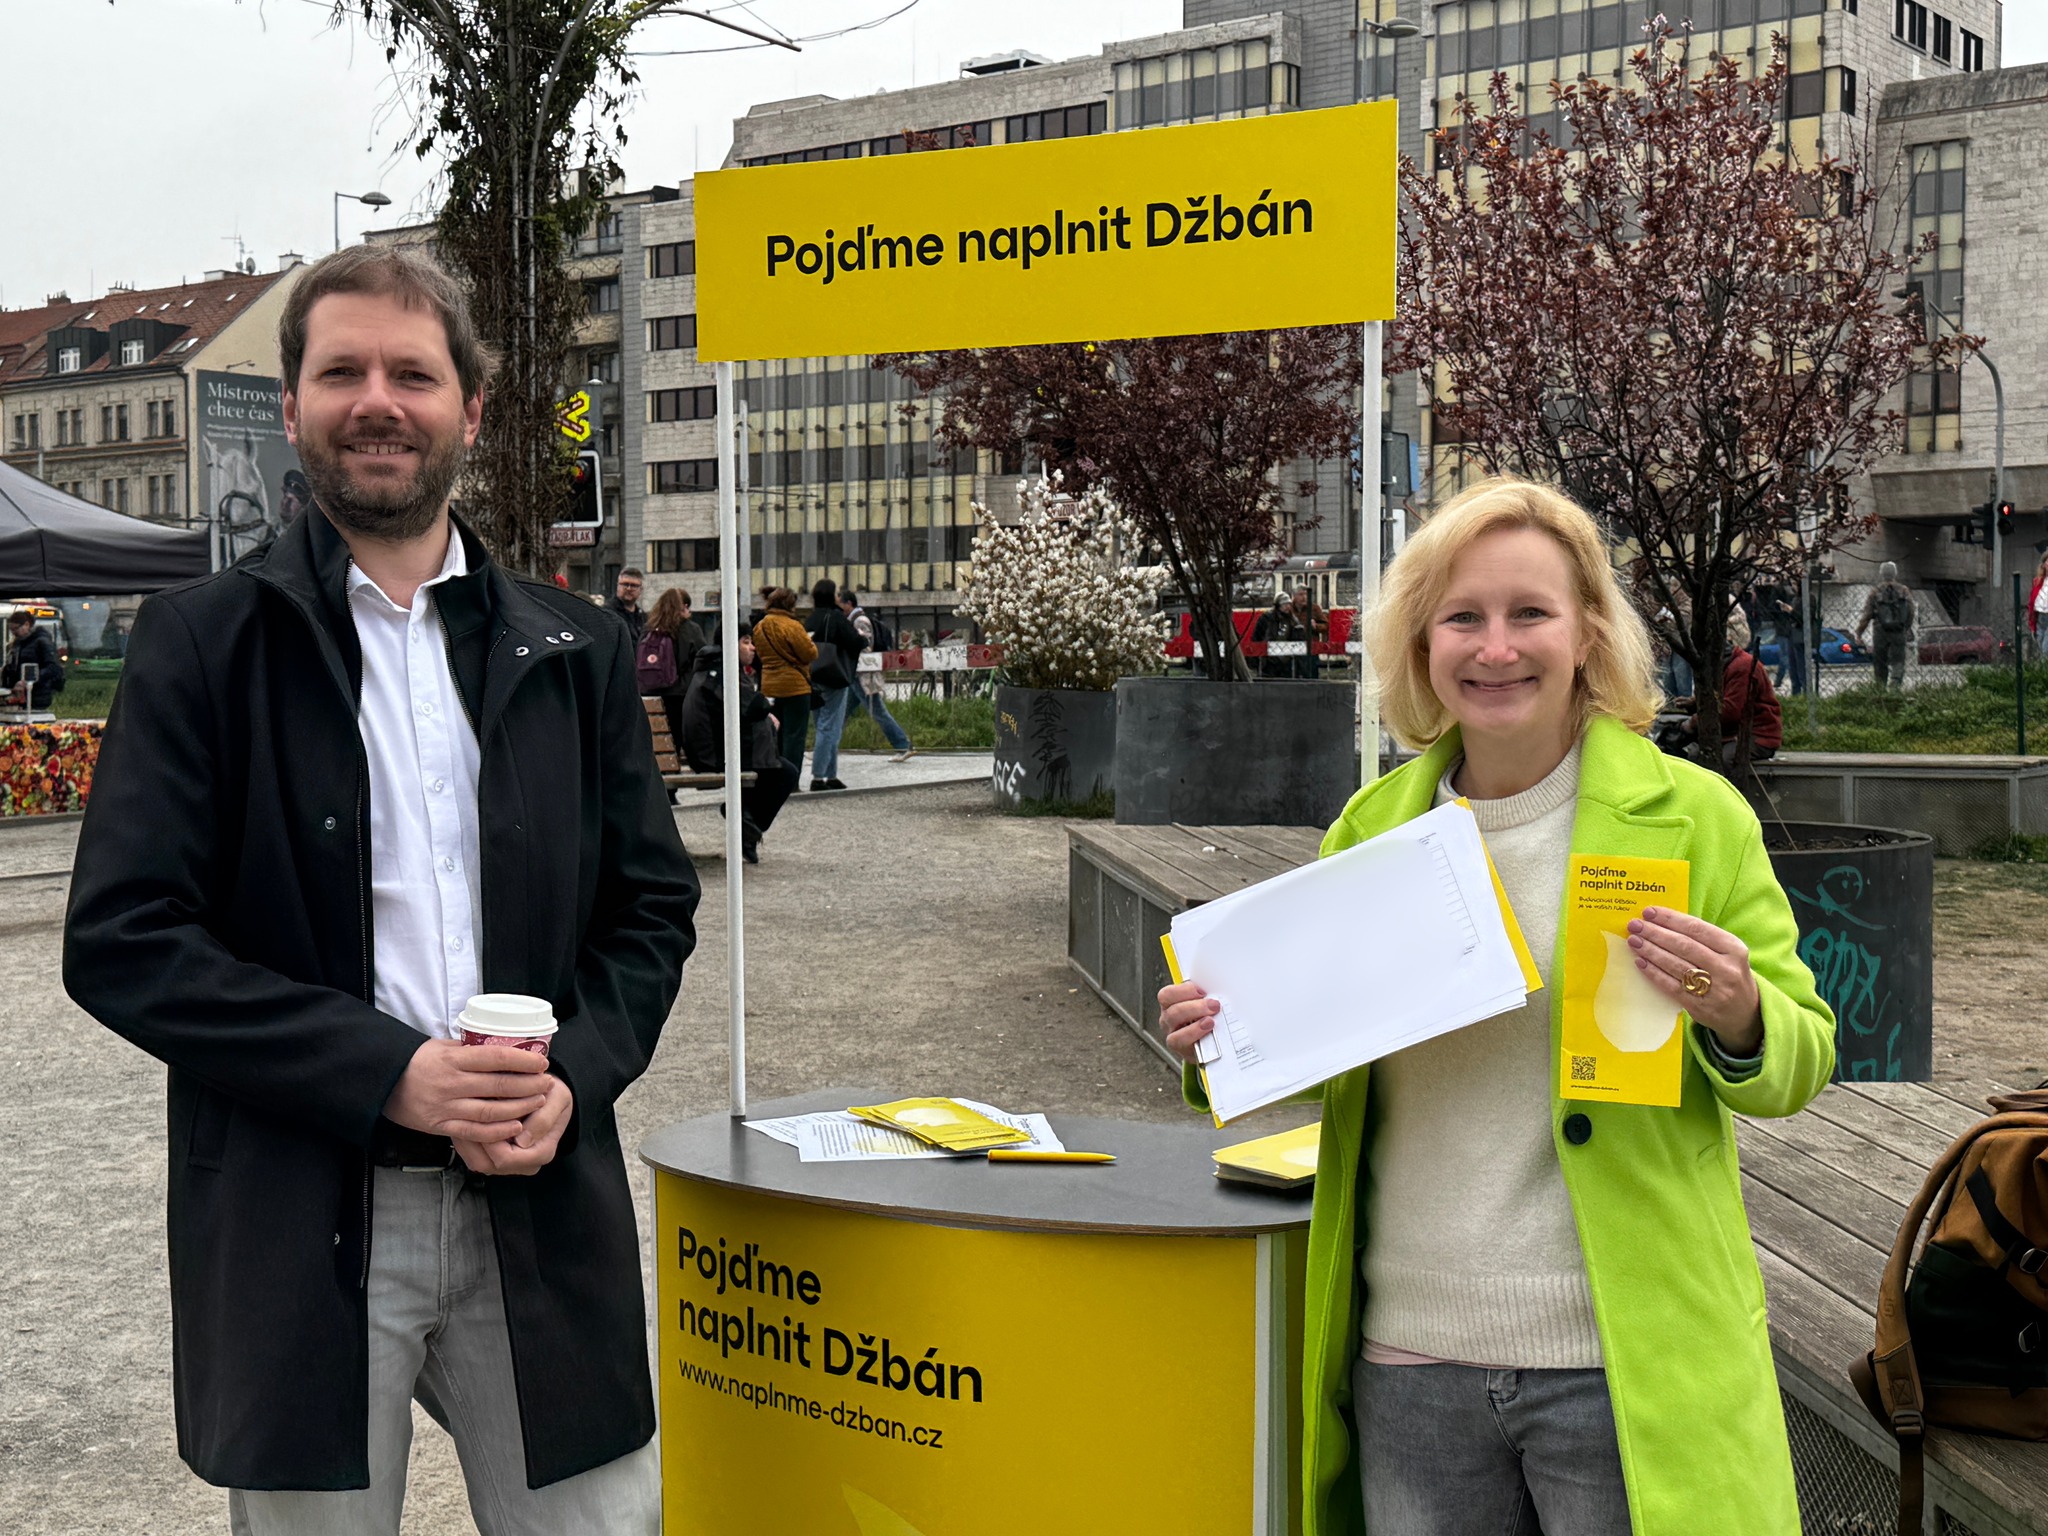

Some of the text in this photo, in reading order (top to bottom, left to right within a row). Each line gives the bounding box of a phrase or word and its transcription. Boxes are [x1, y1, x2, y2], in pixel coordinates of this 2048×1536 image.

[767, 188, 1313, 285] Pojďme naplnit Džbán
[207, 399, 245, 419] chce
[1580, 879, 1666, 893] naplnit Džbán
[1581, 865, 1627, 878] Pojďme
[678, 1226, 822, 1306] Pojďme
[679, 1298, 983, 1403] naplnit Džbán
[678, 1358, 944, 1449] www.naplnme-dzban.cz
